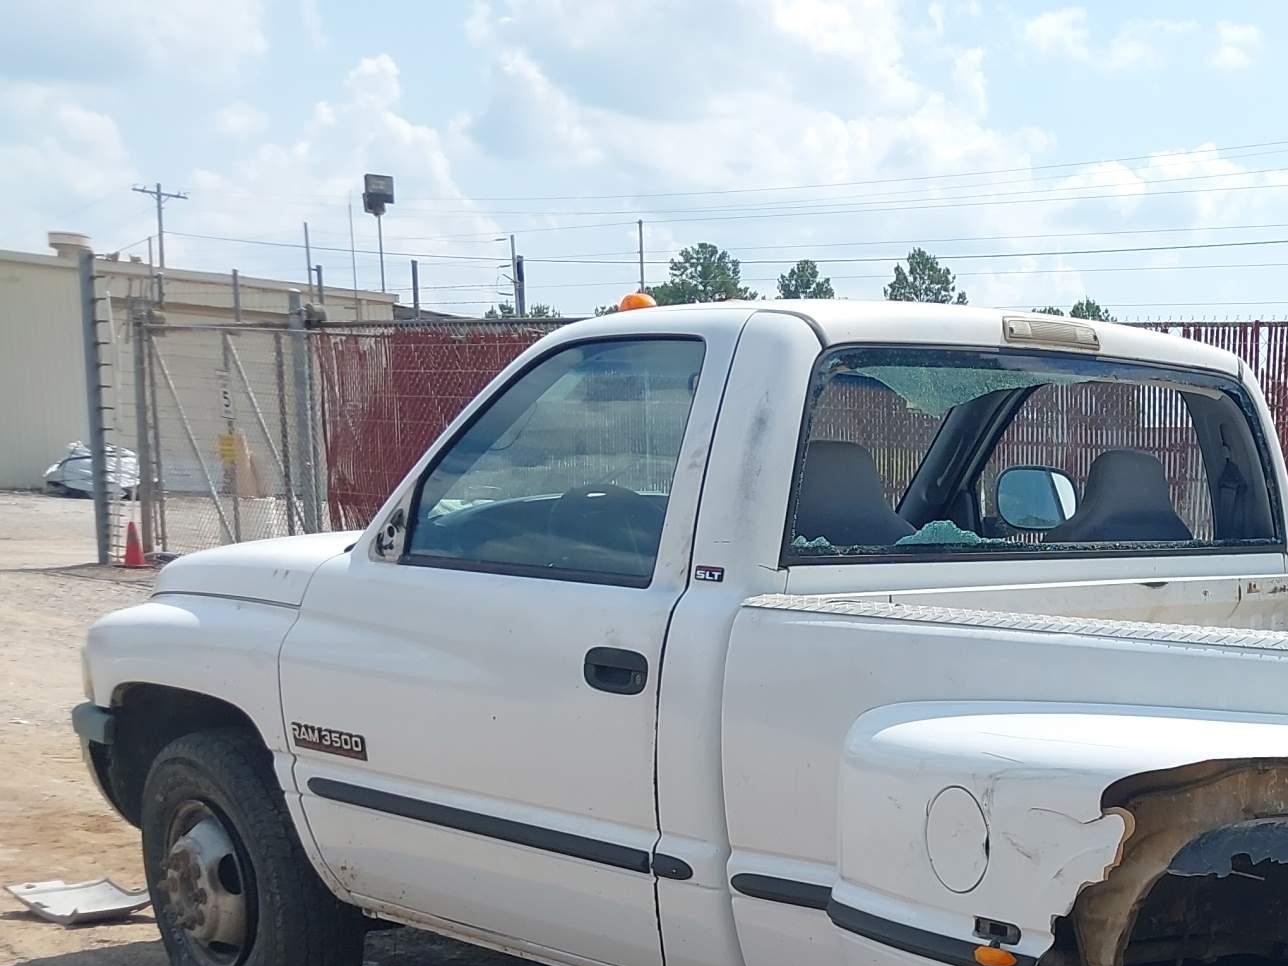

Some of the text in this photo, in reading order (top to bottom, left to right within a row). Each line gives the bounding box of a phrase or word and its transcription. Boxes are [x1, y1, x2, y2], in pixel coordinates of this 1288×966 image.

[695, 570, 722, 580] SLT
[290, 723, 362, 752] RAM 3500
